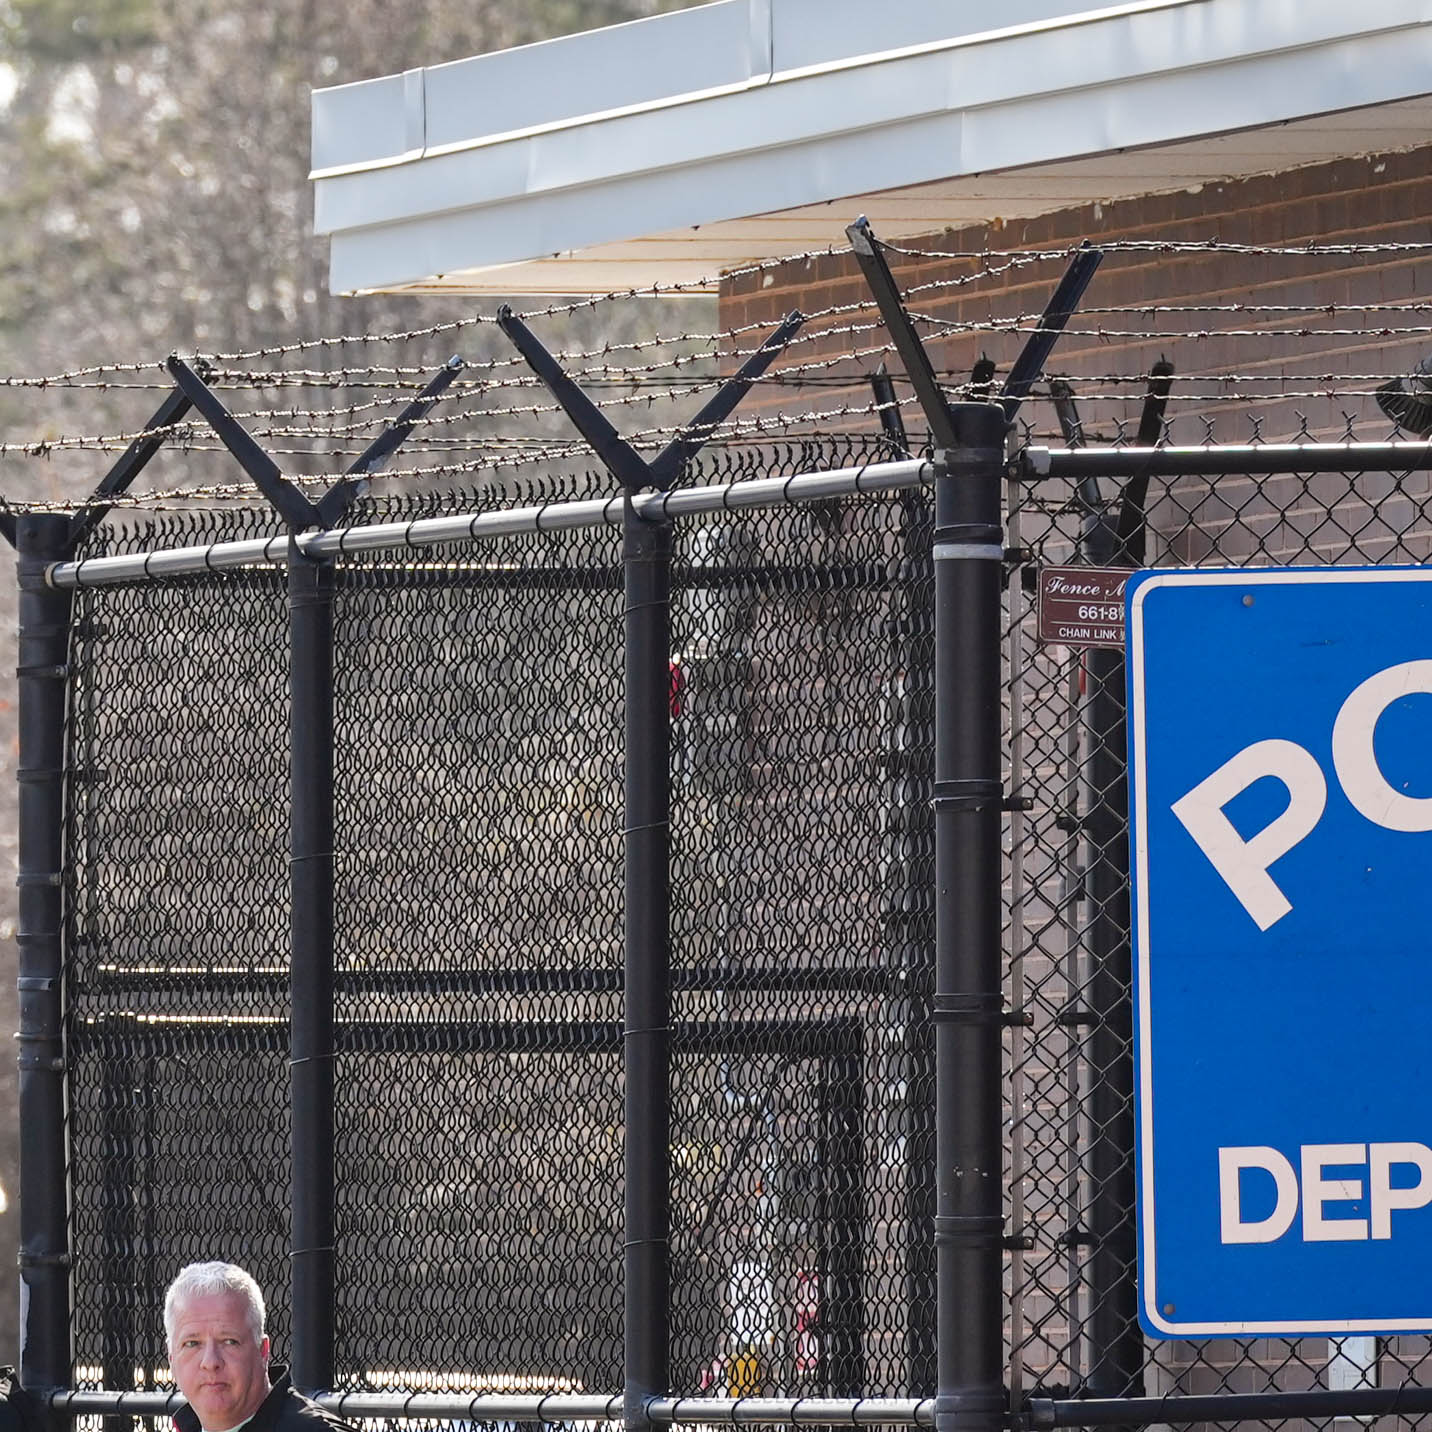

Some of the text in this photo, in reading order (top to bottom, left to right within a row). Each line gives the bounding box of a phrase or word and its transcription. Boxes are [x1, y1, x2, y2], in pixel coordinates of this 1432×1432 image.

[1045, 576, 1101, 595] Fence
[1058, 627, 1117, 640] CHAIN LINK
